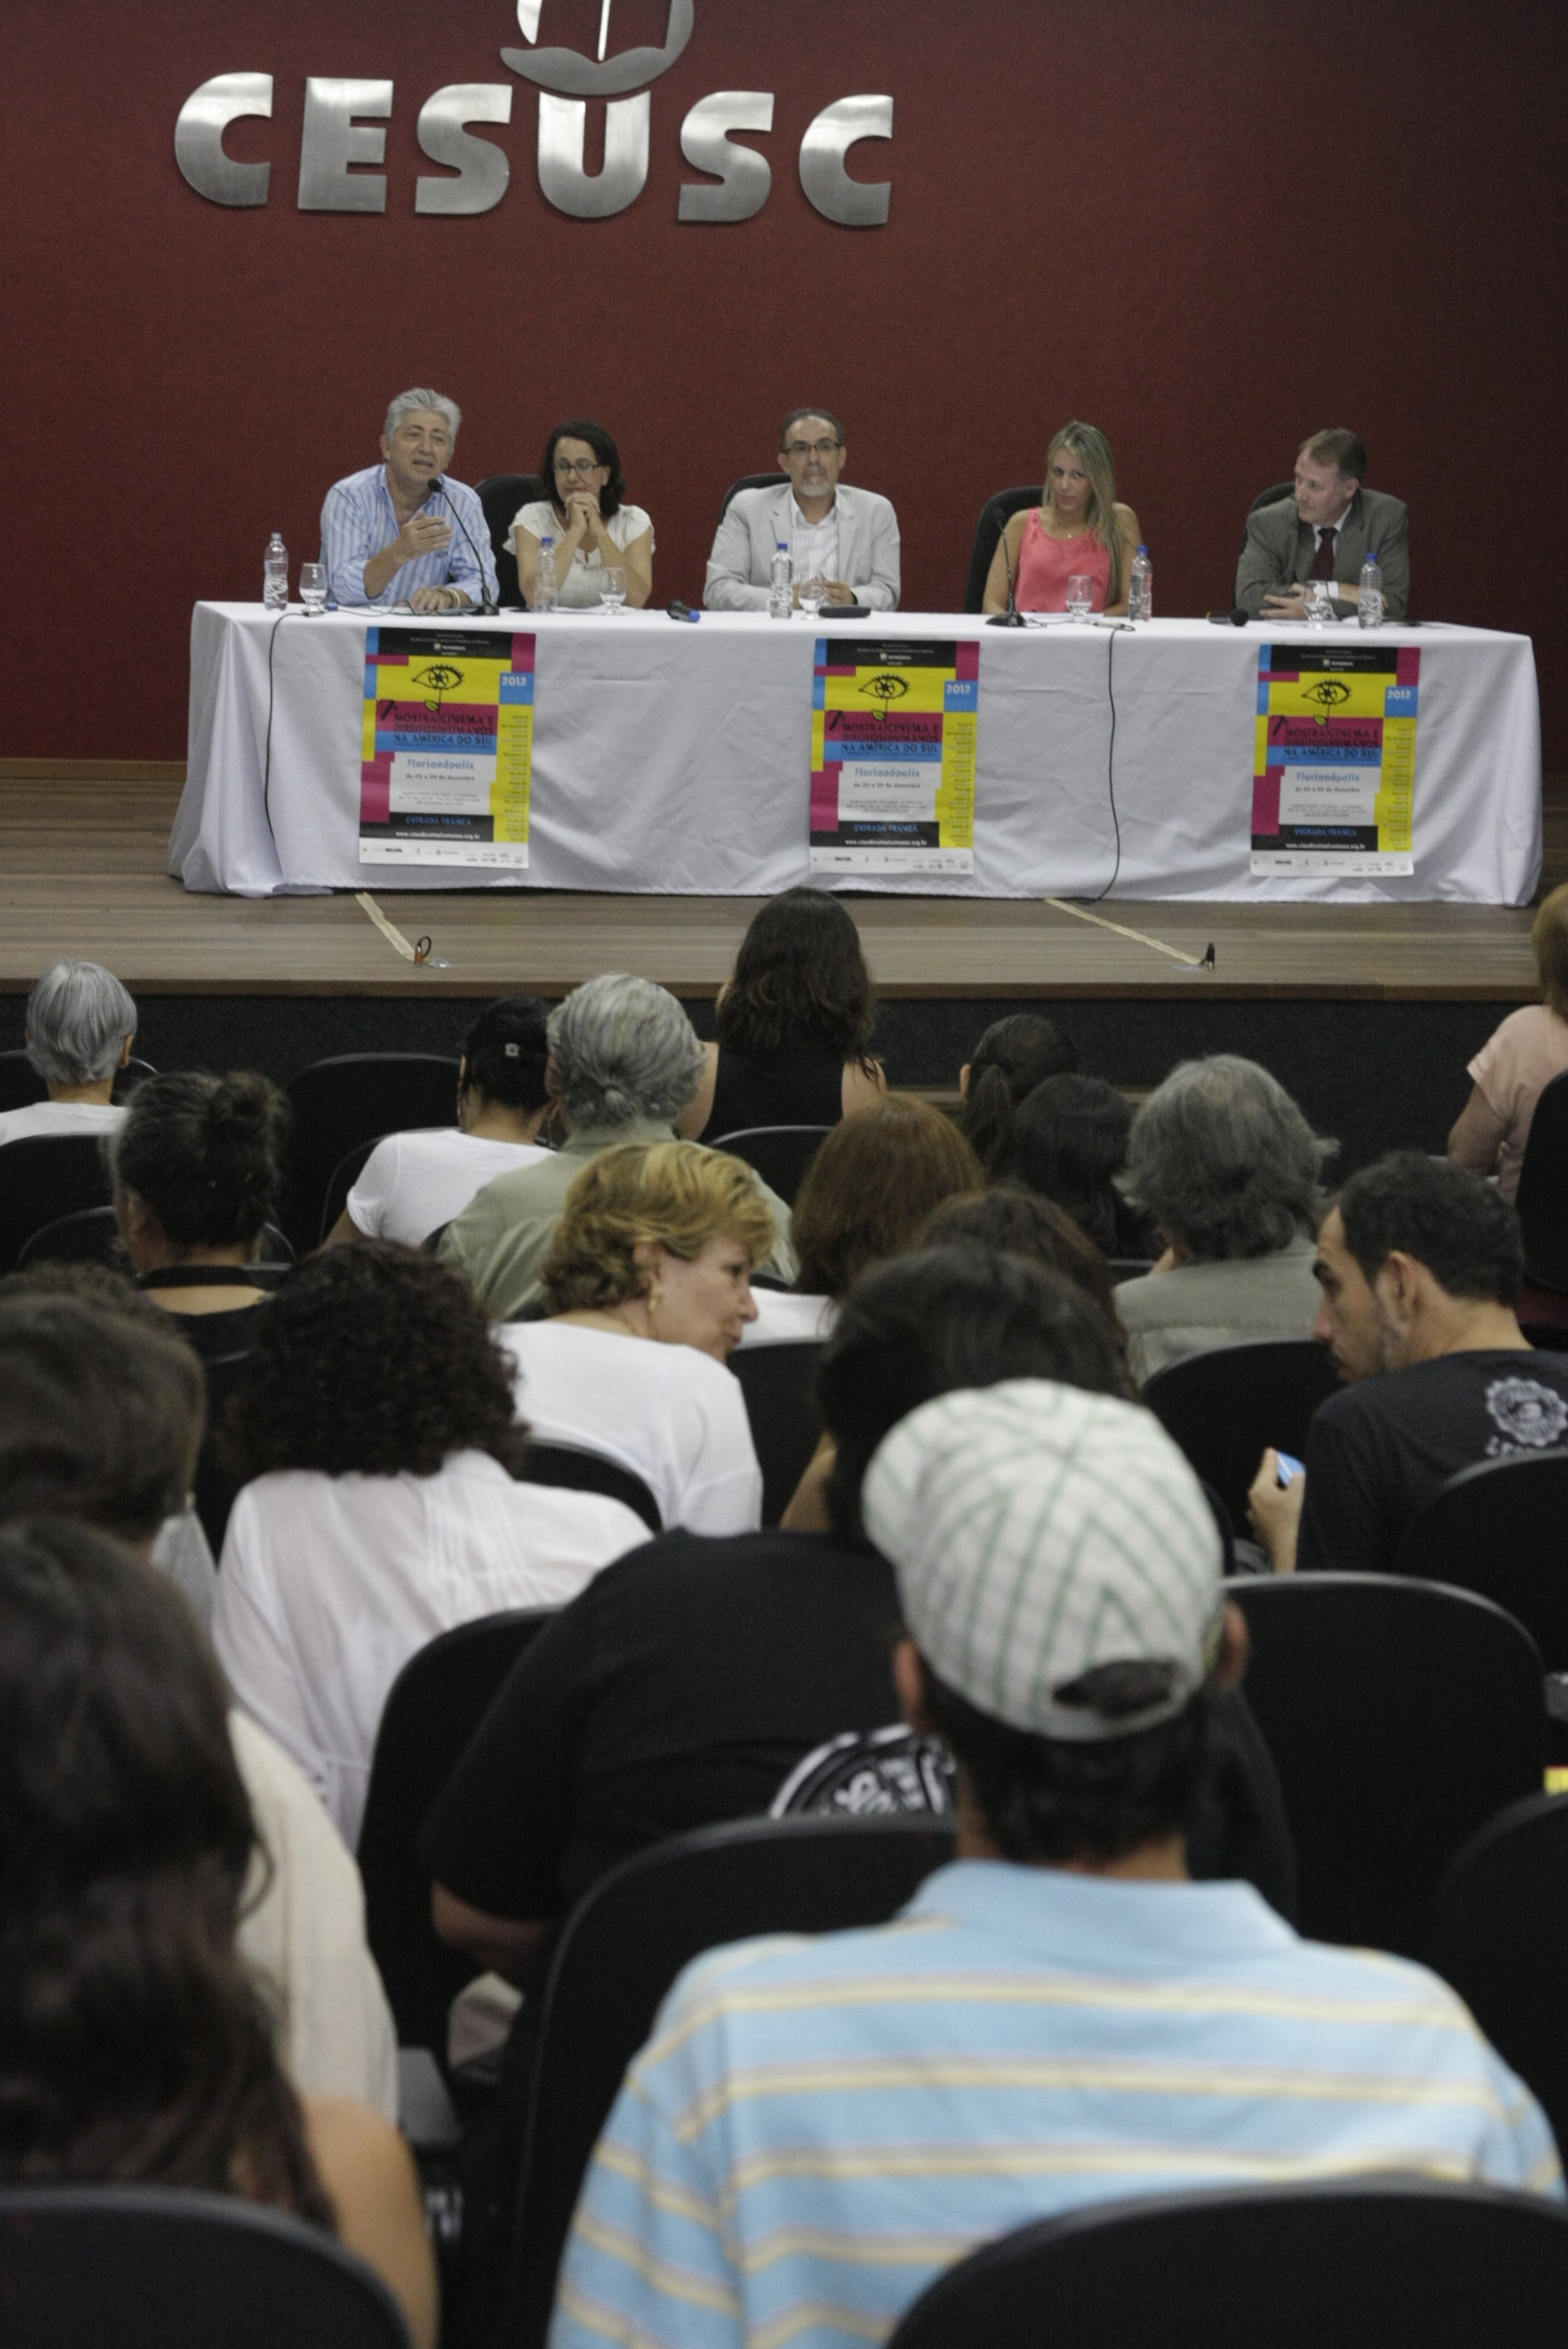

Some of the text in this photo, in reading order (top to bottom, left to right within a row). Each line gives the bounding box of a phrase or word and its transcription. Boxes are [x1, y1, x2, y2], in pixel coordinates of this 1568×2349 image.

[174, 72, 894, 227] CESUSC
[502, 677, 527, 687] 2012
[946, 684, 971, 694] 2012
[1386, 689, 1411, 700] 2012
[394, 713, 436, 723] MOSTRA
[440, 714, 483, 725] CINEMA
[458, 735, 472, 744] DO
[475, 736, 493, 745] SUL
